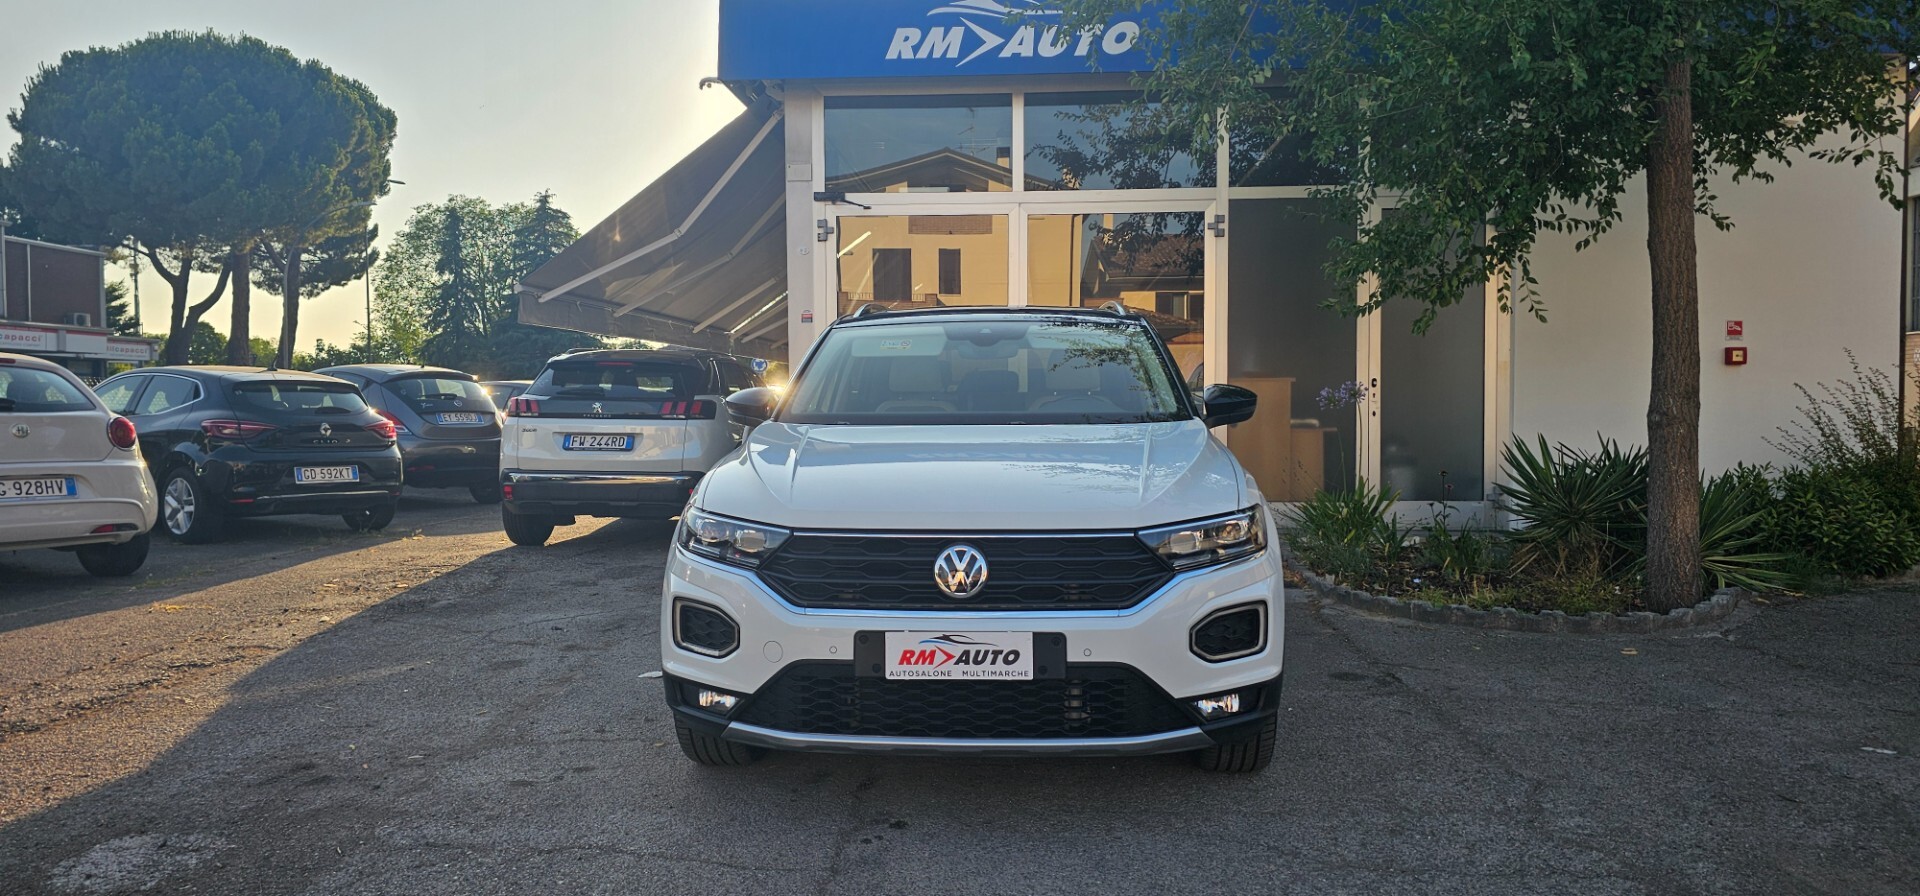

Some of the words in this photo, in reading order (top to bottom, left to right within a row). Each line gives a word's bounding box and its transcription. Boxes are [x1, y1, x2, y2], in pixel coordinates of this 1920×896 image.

[885, 27, 965, 59] RM
[998, 21, 1140, 57] AUTO
[571, 436, 586, 447] FW
[589, 436, 625, 447] 244RD
[320, 467, 351, 480] 592KT
[12, 480, 63, 496] 928HV
[898, 649, 937, 666] RM
[953, 649, 1021, 666] AUTO
